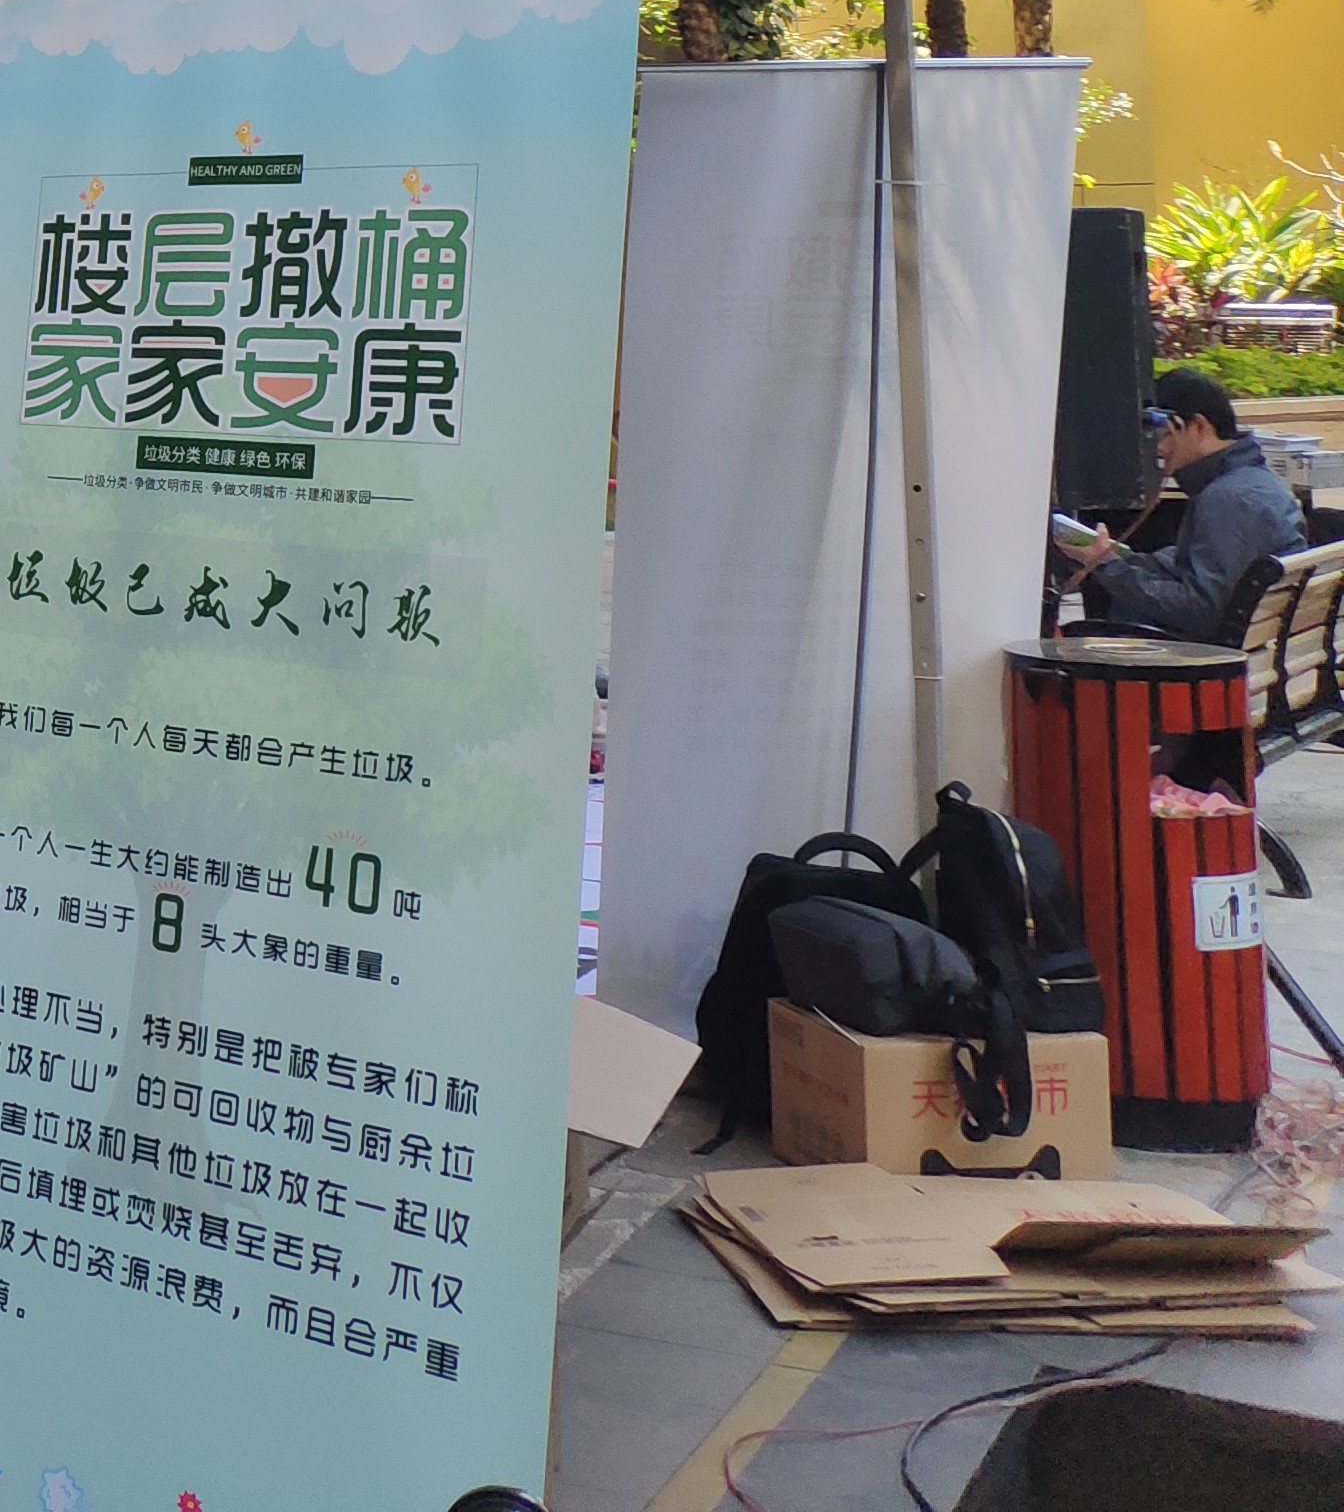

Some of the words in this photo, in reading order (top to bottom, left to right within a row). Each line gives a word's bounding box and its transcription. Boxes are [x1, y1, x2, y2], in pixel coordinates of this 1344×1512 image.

[190, 164, 238, 177] HEALTHY
[238, 164, 264, 176] AND
[265, 163, 302, 176] GREEN
[34, 208, 469, 320] 楼层撤桶
[23, 319, 462, 438] 家家安康
[143, 444, 201, 465] 垃圾分类
[205, 447, 236, 467] 健康
[239, 449, 272, 469] 绿色
[274, 451, 306, 471] 环保
